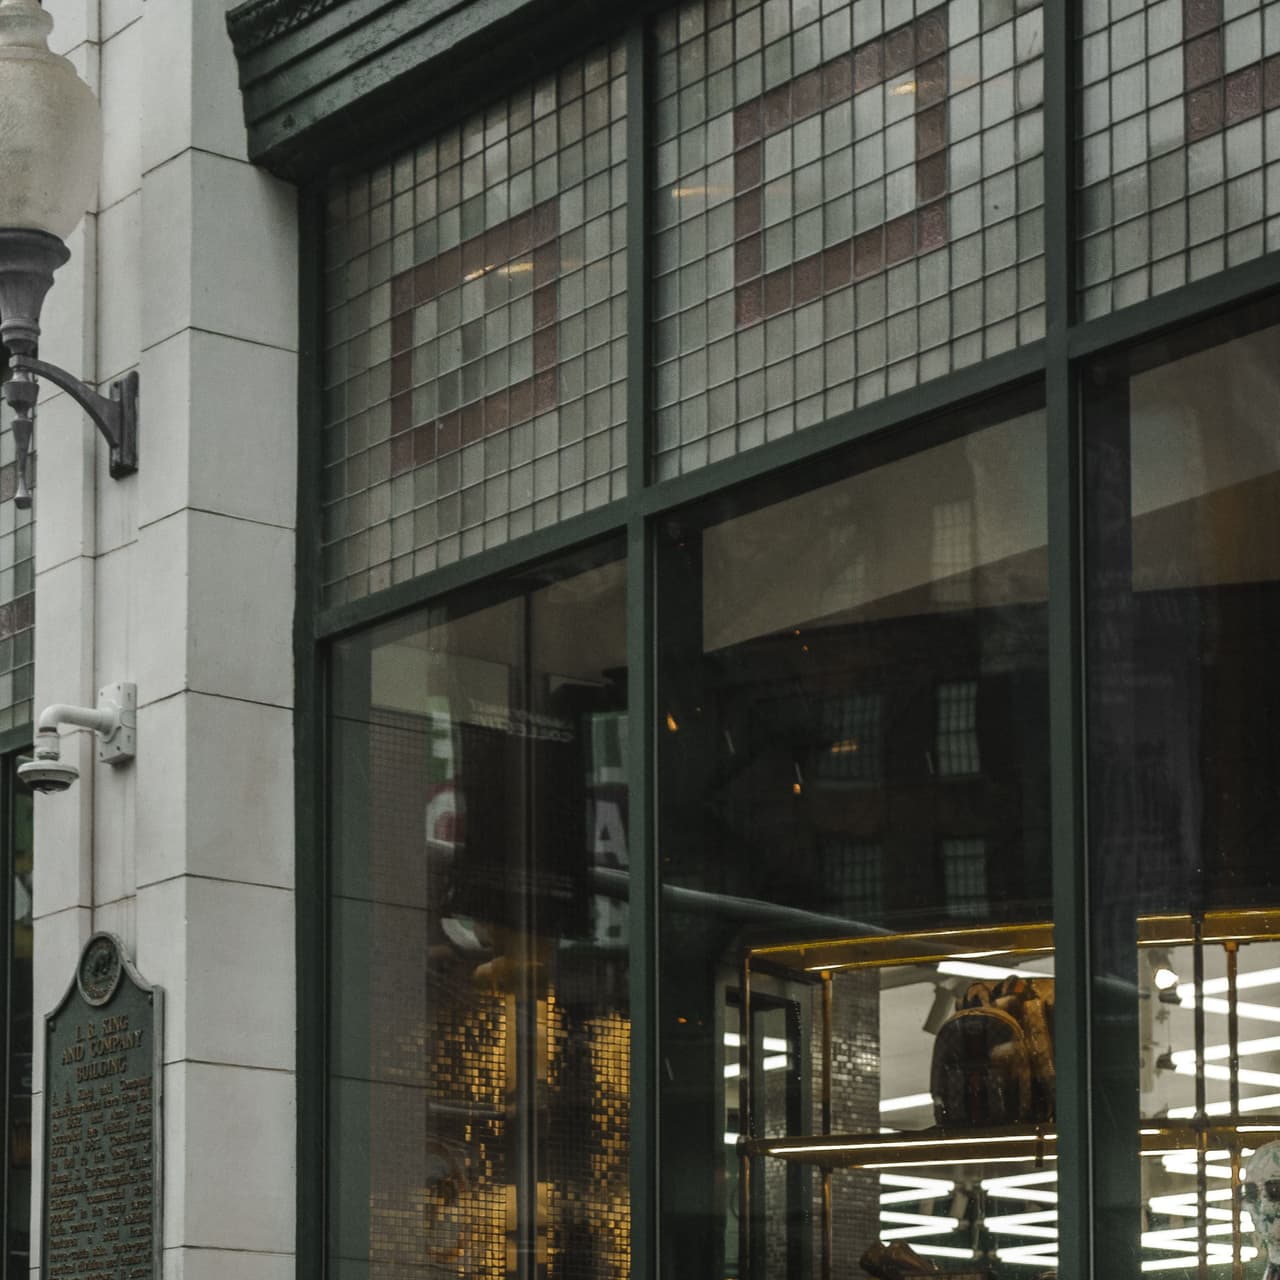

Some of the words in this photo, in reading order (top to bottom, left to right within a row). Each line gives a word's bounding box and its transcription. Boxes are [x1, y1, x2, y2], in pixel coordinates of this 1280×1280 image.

[103, 1016, 128, 1035] KING
[62, 1045, 84, 1065] AND
[90, 1031, 143, 1057] COMPANY
[76, 1058, 127, 1083] BUILDING
